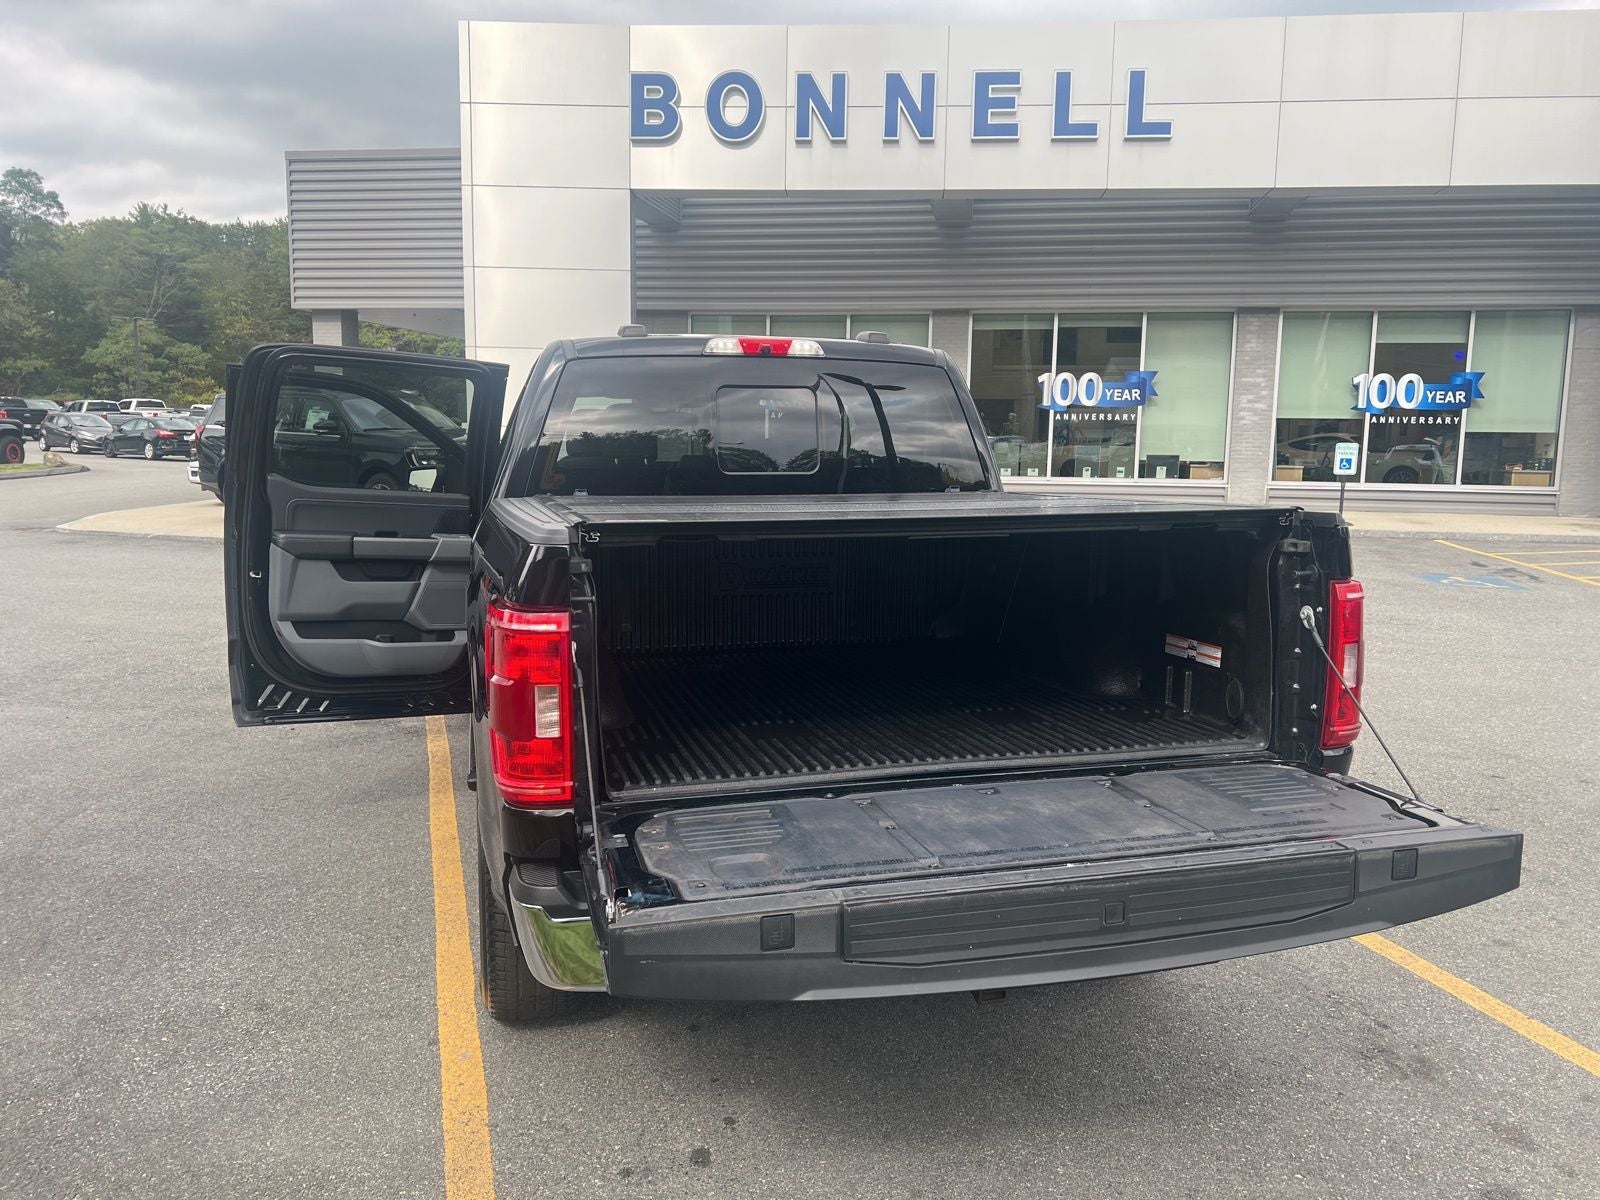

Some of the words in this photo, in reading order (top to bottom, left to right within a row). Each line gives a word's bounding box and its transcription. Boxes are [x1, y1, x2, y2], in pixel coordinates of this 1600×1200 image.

[630, 68, 1174, 142] BONNELL
[1037, 371, 1103, 407] 100
[1105, 388, 1141, 401] YEAR
[1352, 372, 1424, 410] 100
[1426, 390, 1466, 404] YEAR
[1055, 413, 1136, 421] ANNIVERSARY
[1370, 416, 1460, 425] ANNIVERSARY
